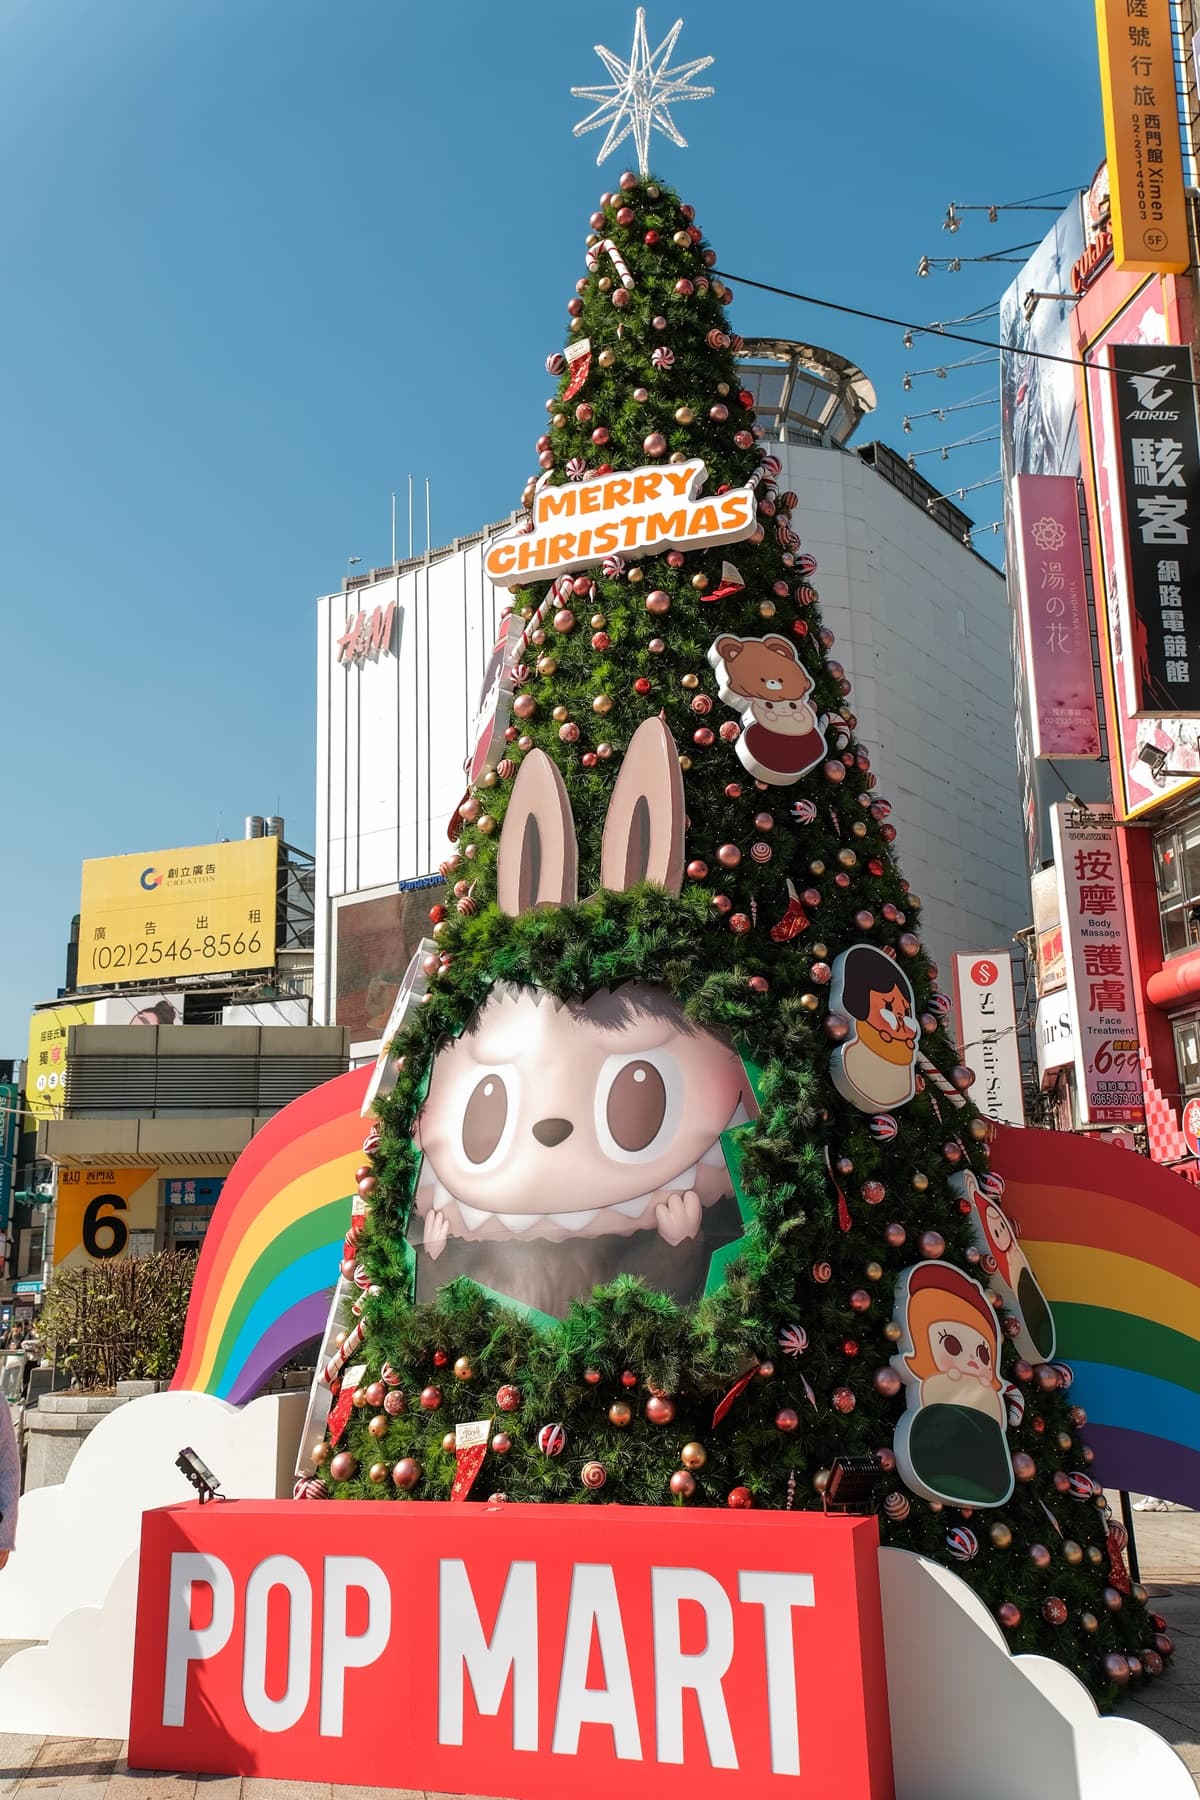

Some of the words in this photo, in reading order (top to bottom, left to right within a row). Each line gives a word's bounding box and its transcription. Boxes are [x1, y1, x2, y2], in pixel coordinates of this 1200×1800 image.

[1126, 0, 1156, 107] 陸號行旅
[1144, 113, 1164, 164] 西門館
[1149, 168, 1164, 221] Ximen
[1147, 234, 1163, 246] 5F
[1126, 410, 1181, 422] AORUS
[538, 467, 697, 524] MERRY
[1131, 437, 1191, 545] 駭客
[486, 496, 749, 575] CHRISTMAS
[336, 600, 398, 664] H&M
[1040, 560, 1071, 653] 湯の花
[1157, 560, 1190, 682] 網路電競館
[167, 863, 217, 880] 創立廣告
[167, 875, 216, 888] CREATION
[1074, 849, 1118, 916] 按摩
[1081, 928, 1121, 940] Massage
[1088, 919, 1112, 930] Body
[92, 930, 262, 971] (02)2546-8566
[979, 992, 995, 1015] SJ
[1083, 944, 1126, 1013] 護膚
[1087, 1026, 1135, 1036] Treatment
[1099, 1016, 1122, 1025] Face
[981, 1028, 999, 1074] Hair
[986, 1077, 1003, 1120] Salo
[82, 1193, 128, 1259] 6
[162, 1552, 391, 1738] POP
[437, 1558, 816, 1776] MART
